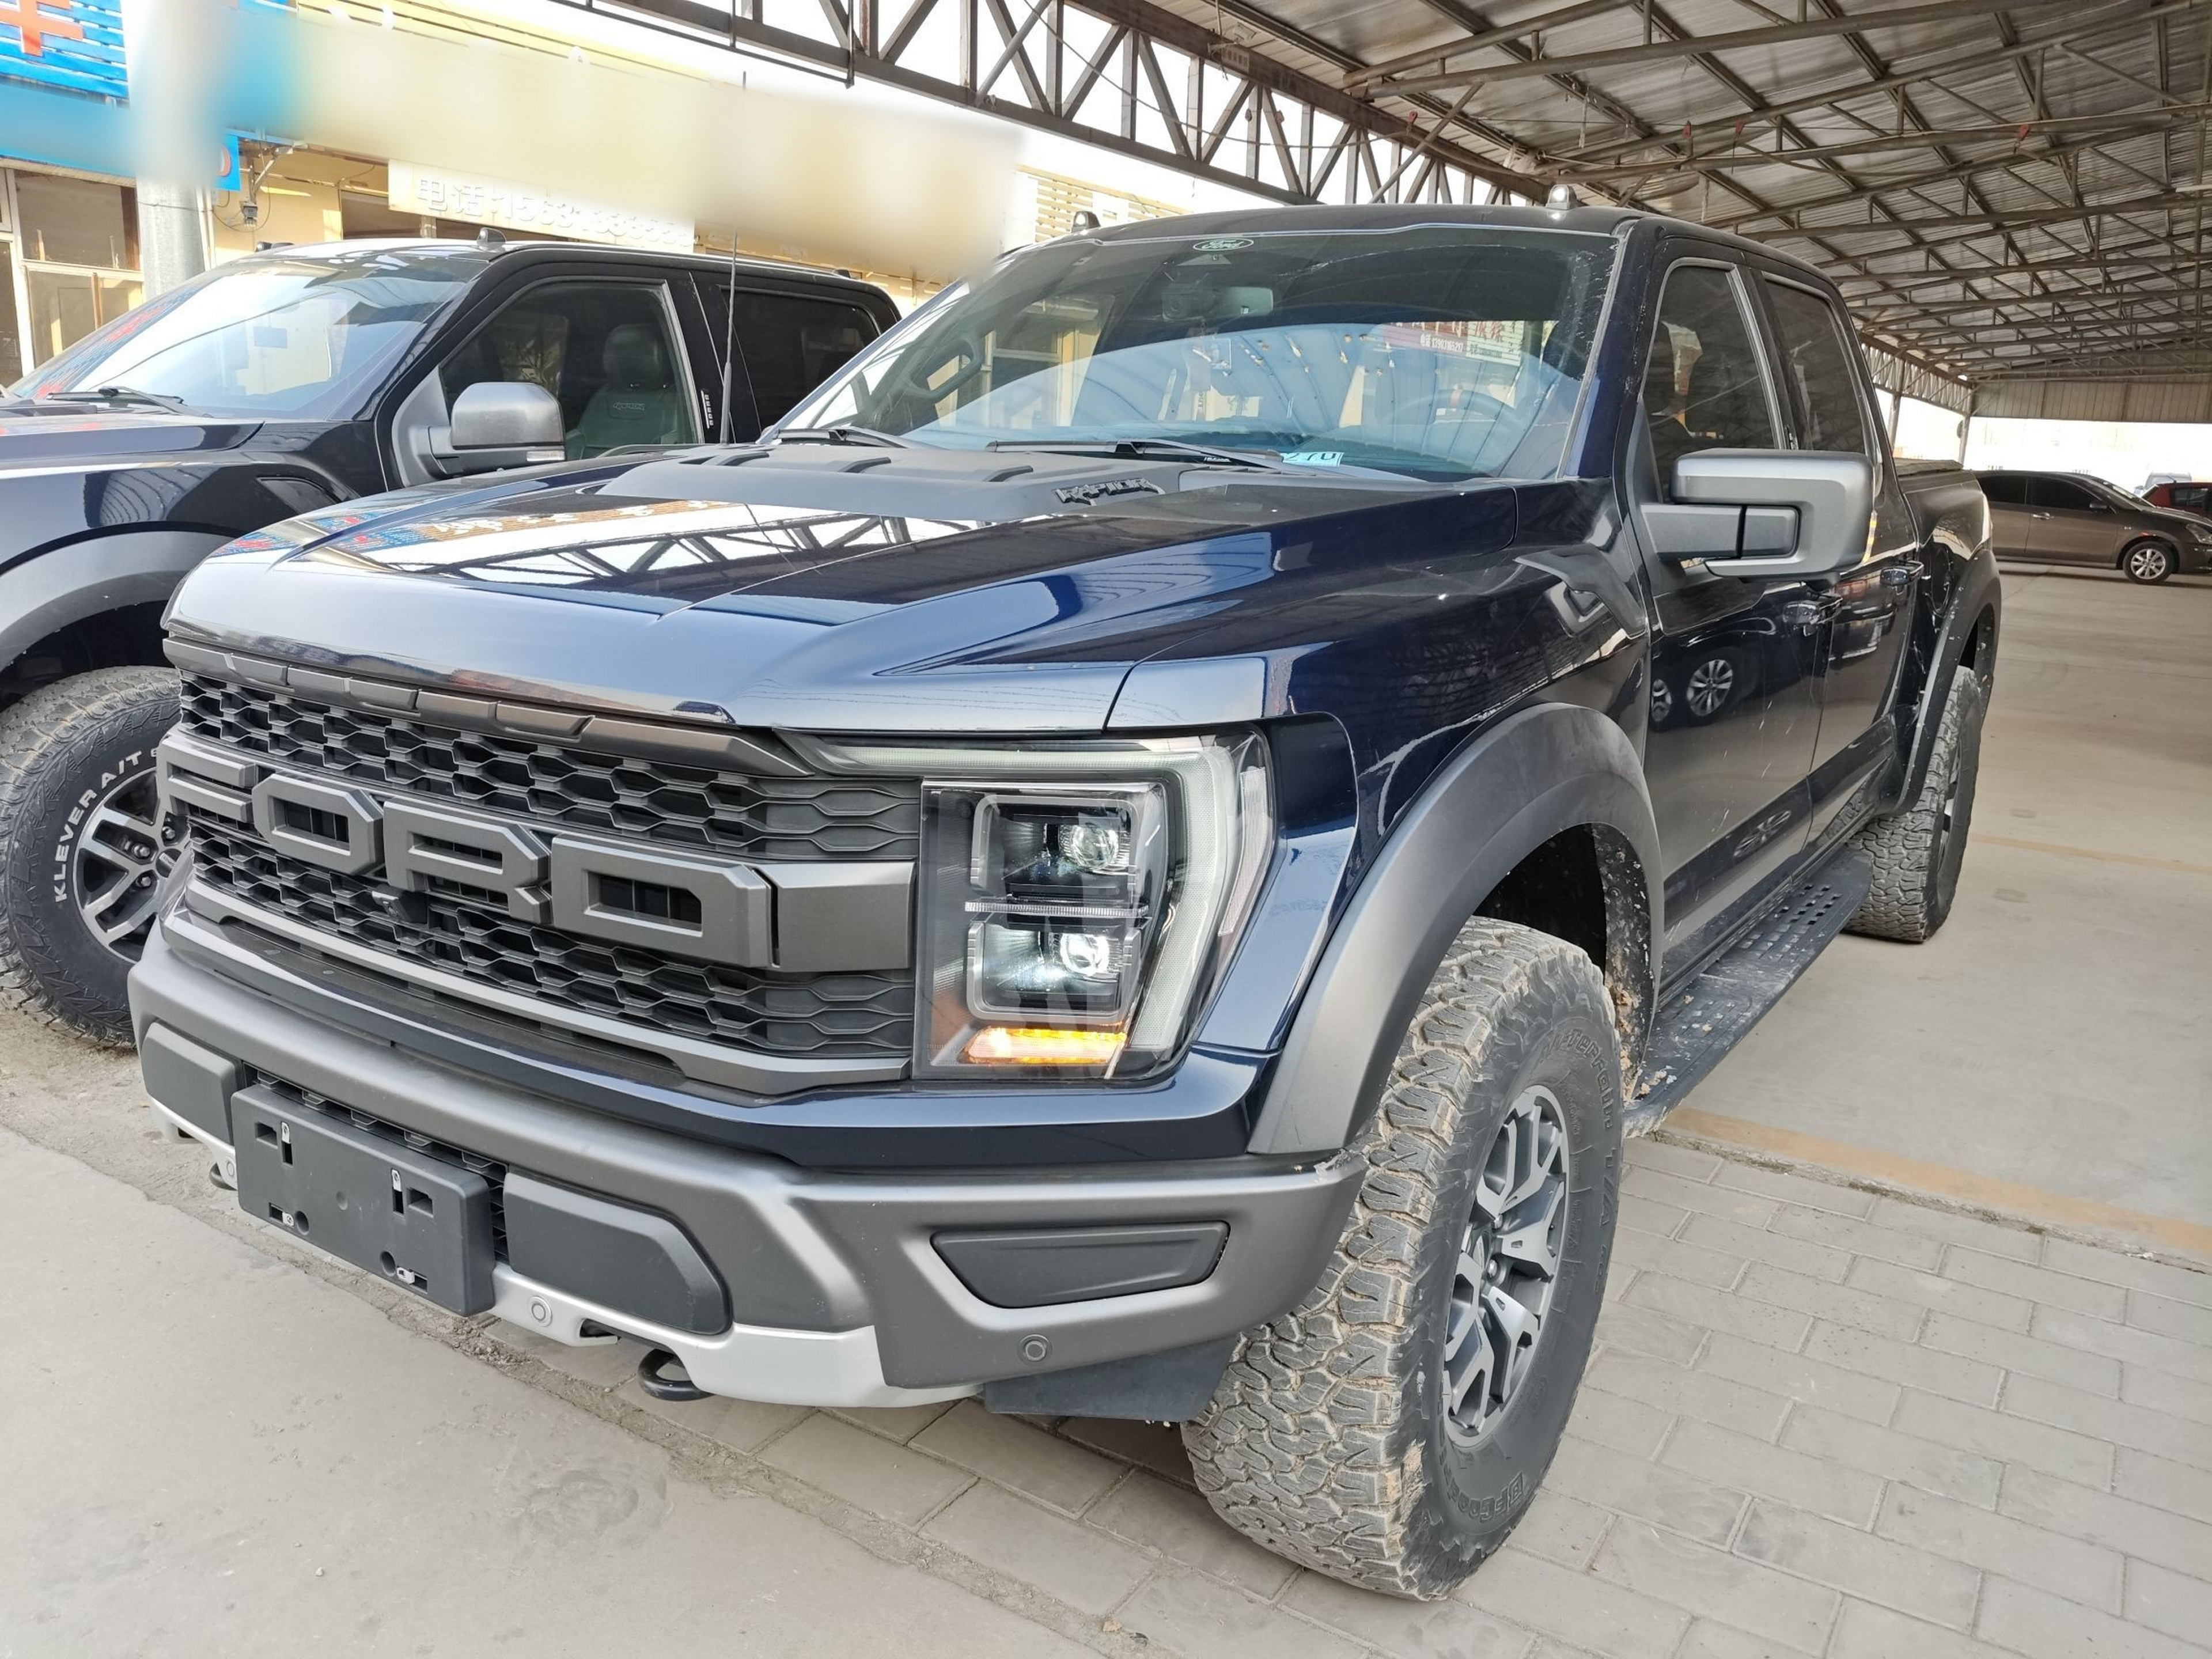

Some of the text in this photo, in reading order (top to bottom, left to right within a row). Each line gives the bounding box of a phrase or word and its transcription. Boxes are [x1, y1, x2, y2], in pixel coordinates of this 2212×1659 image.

[1054, 478, 1166, 506] RAPTOR
[54, 751, 142, 902] KLEVER A/T
[156, 729, 777, 970] FORD
